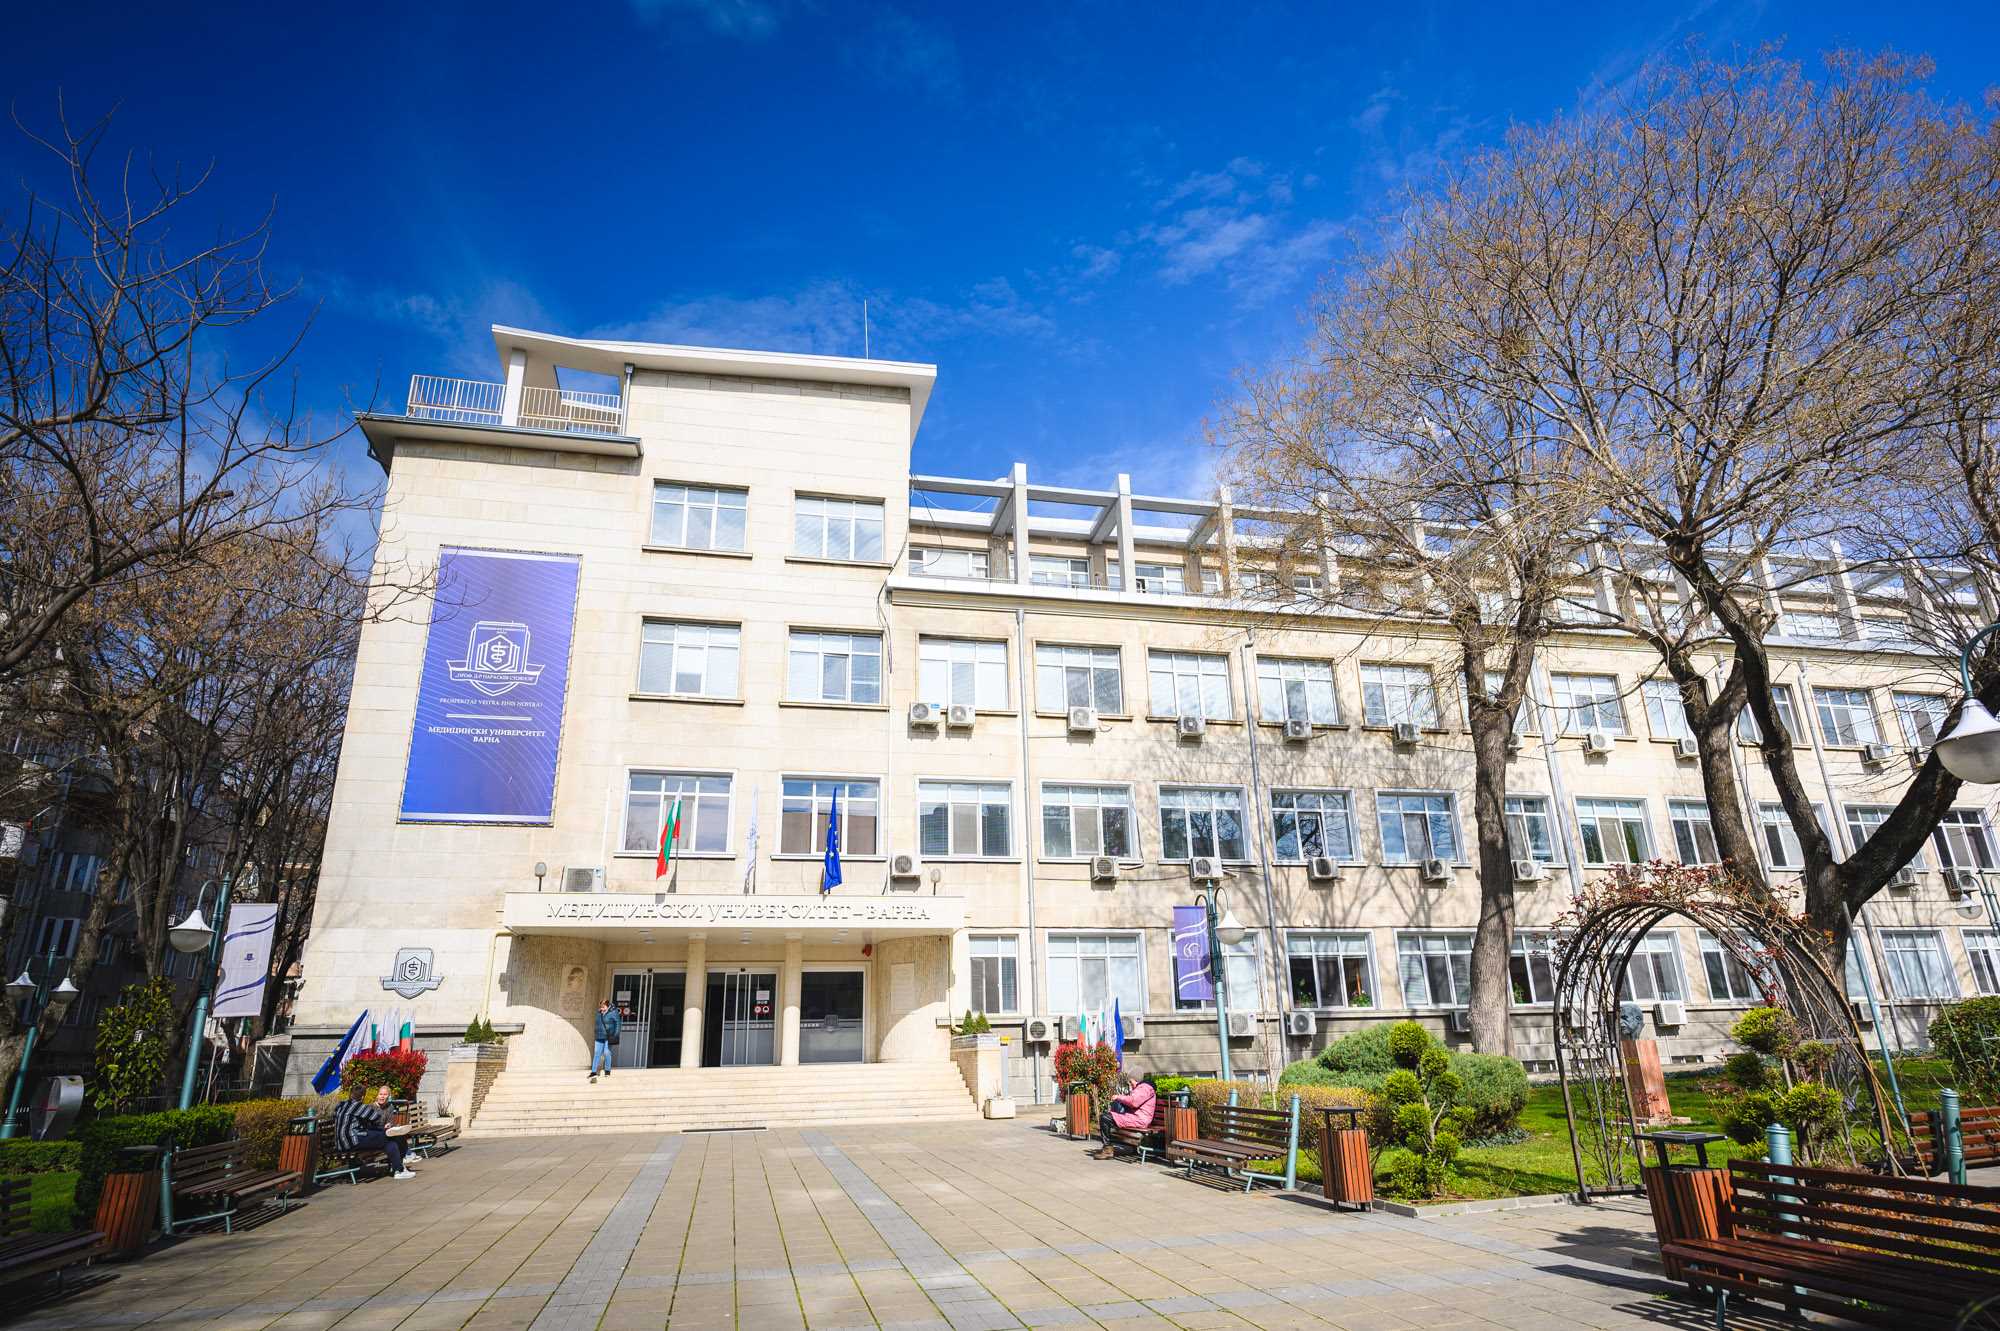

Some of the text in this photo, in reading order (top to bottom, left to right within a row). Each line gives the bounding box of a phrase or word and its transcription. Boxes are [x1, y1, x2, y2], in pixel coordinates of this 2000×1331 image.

[428, 726, 546, 738] МЕДИЦИНСКИ УНИВЕРСИТЕТ
[473, 736, 500, 744] ВАРНА
[547, 903, 702, 921] МЕДИЦИНСКИ
